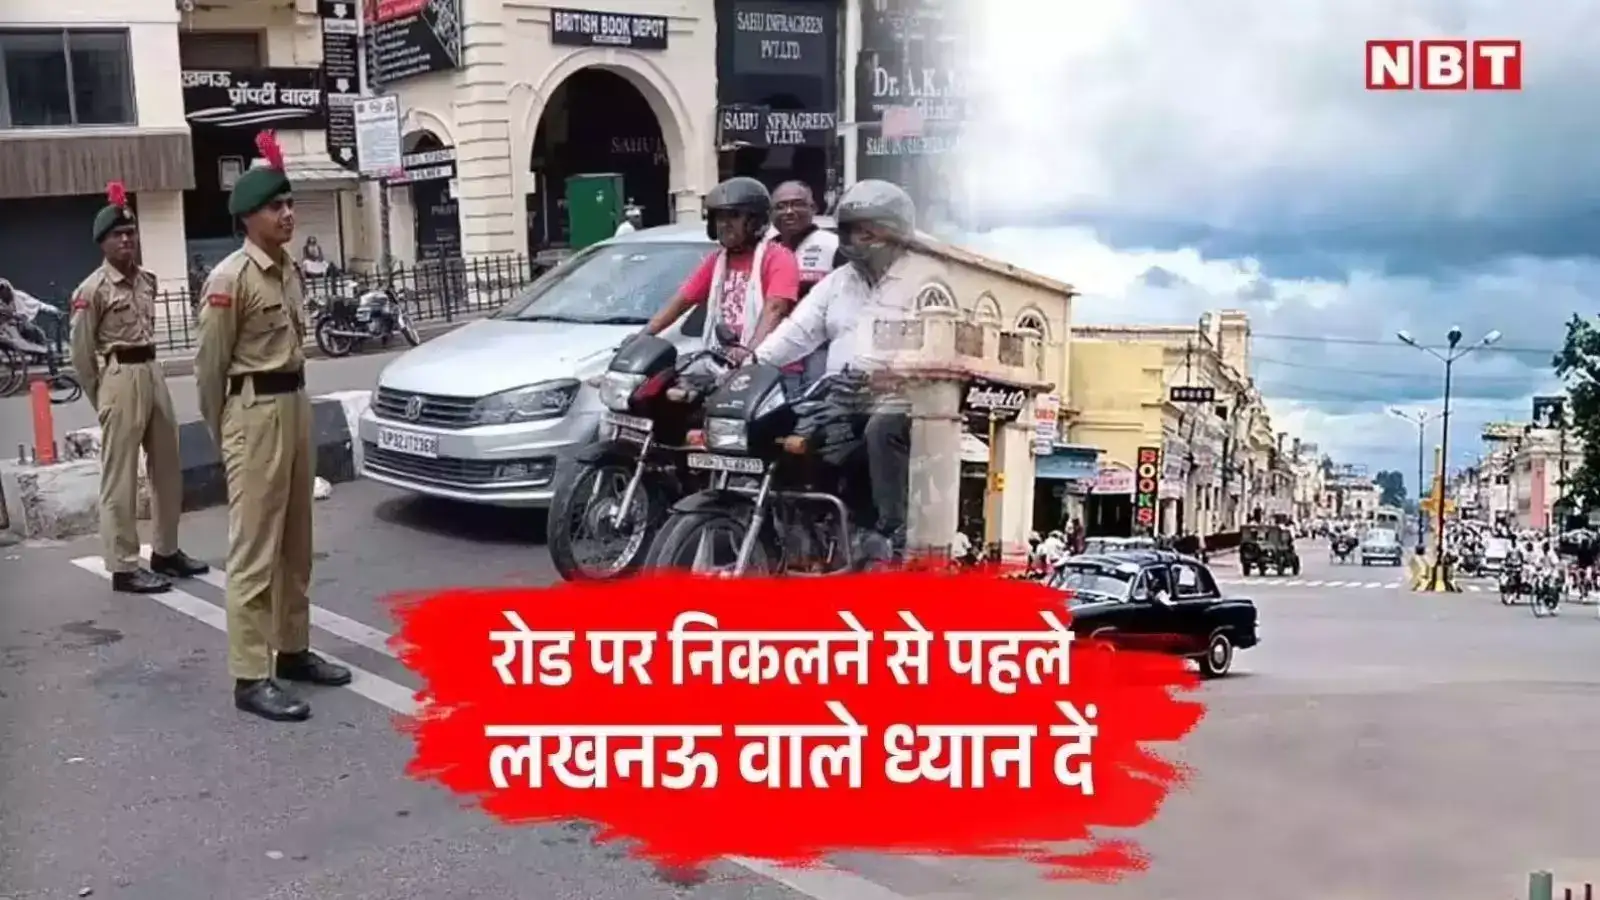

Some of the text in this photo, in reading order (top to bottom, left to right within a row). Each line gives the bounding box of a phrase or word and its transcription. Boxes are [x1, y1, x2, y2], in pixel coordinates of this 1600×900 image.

[555, 12, 665, 38] BRITISH BOOK DEPOT
[737, 12, 765, 32] SAHU
[181, 70, 231, 88] खनऊ
[872, 67, 900, 98] Dr.
[280, 88, 321, 106] वाला
[724, 112, 835, 131] SAHU NFRAGREEN
[1137, 450, 1157, 526] BOOKS
